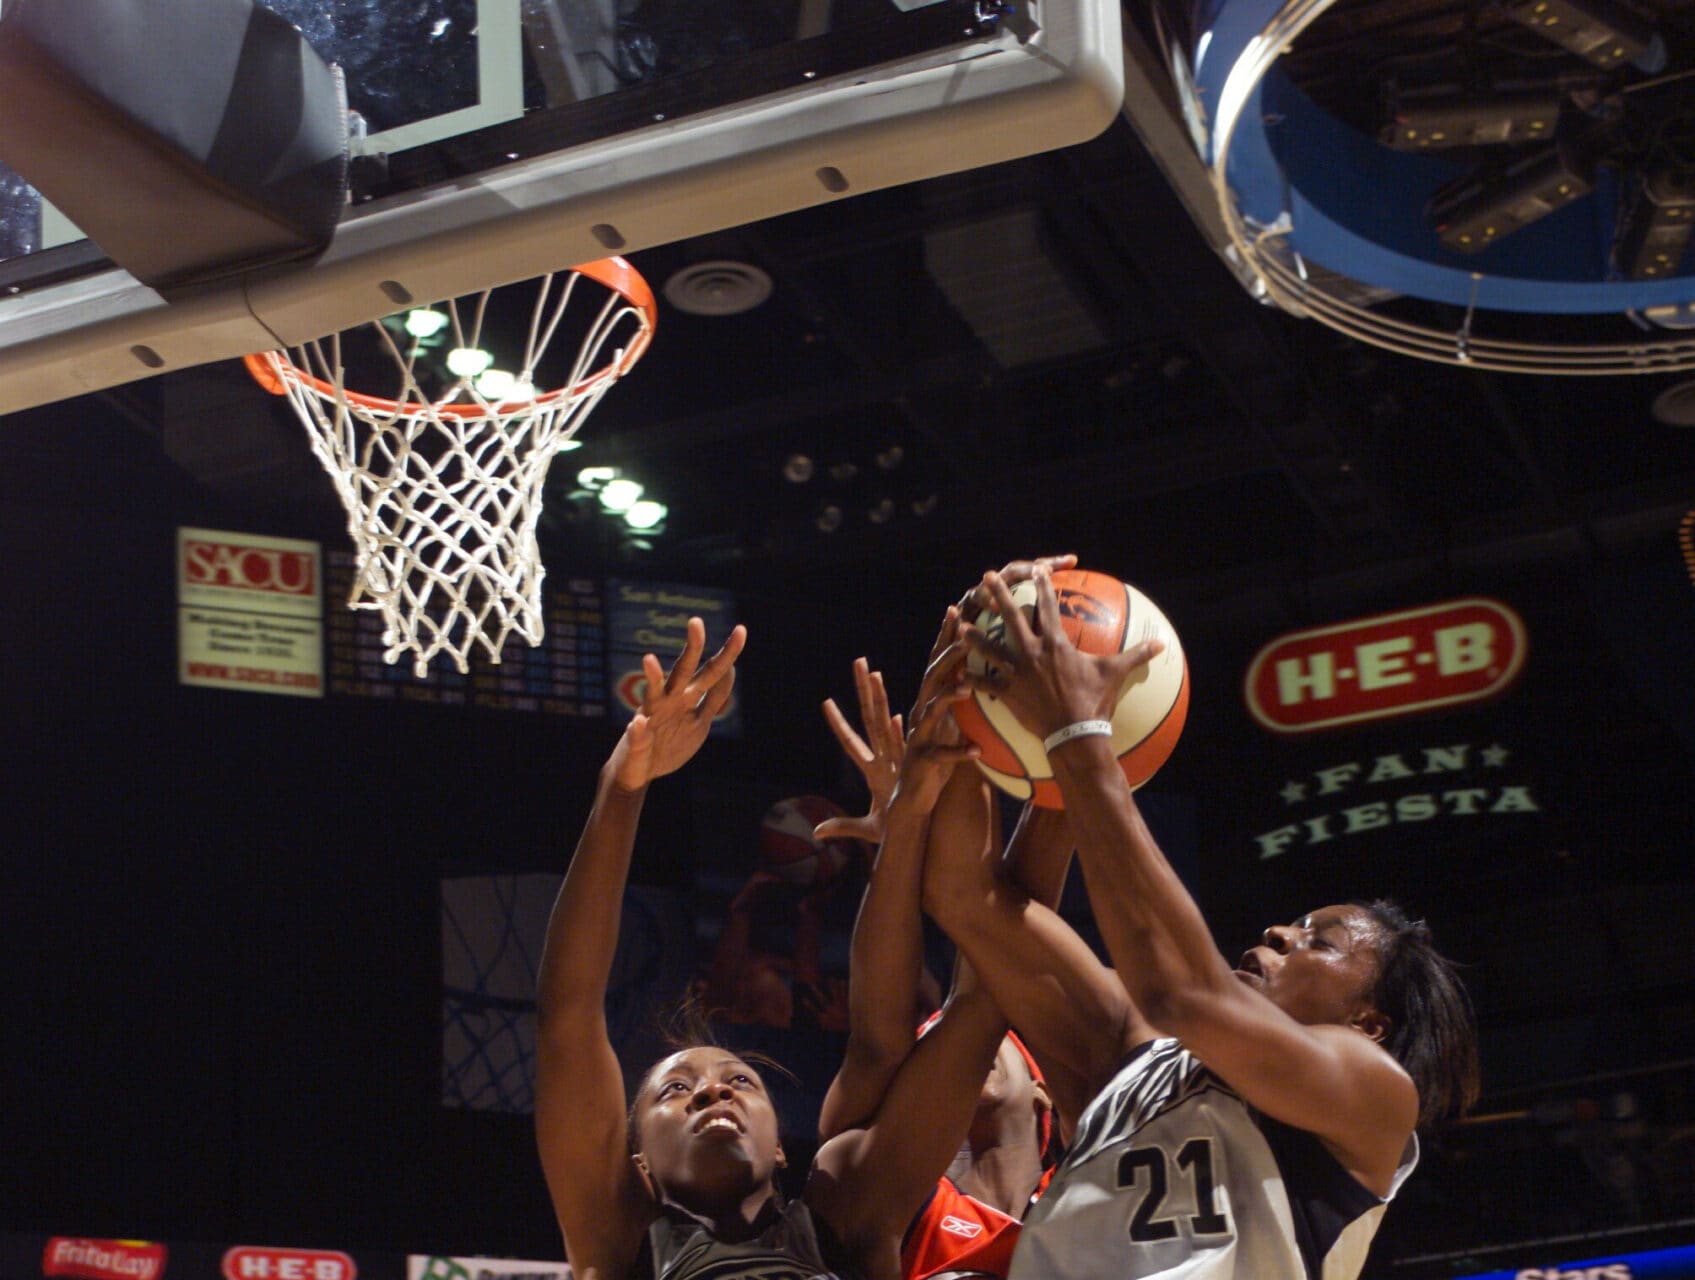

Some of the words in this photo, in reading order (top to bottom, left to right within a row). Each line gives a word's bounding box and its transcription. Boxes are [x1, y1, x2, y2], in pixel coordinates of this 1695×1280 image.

[187, 543, 312, 592] SACU
[1315, 744, 1470, 796] FAN
[1254, 786, 1540, 860] FIESTA
[1116, 1135, 1234, 1246] 21
